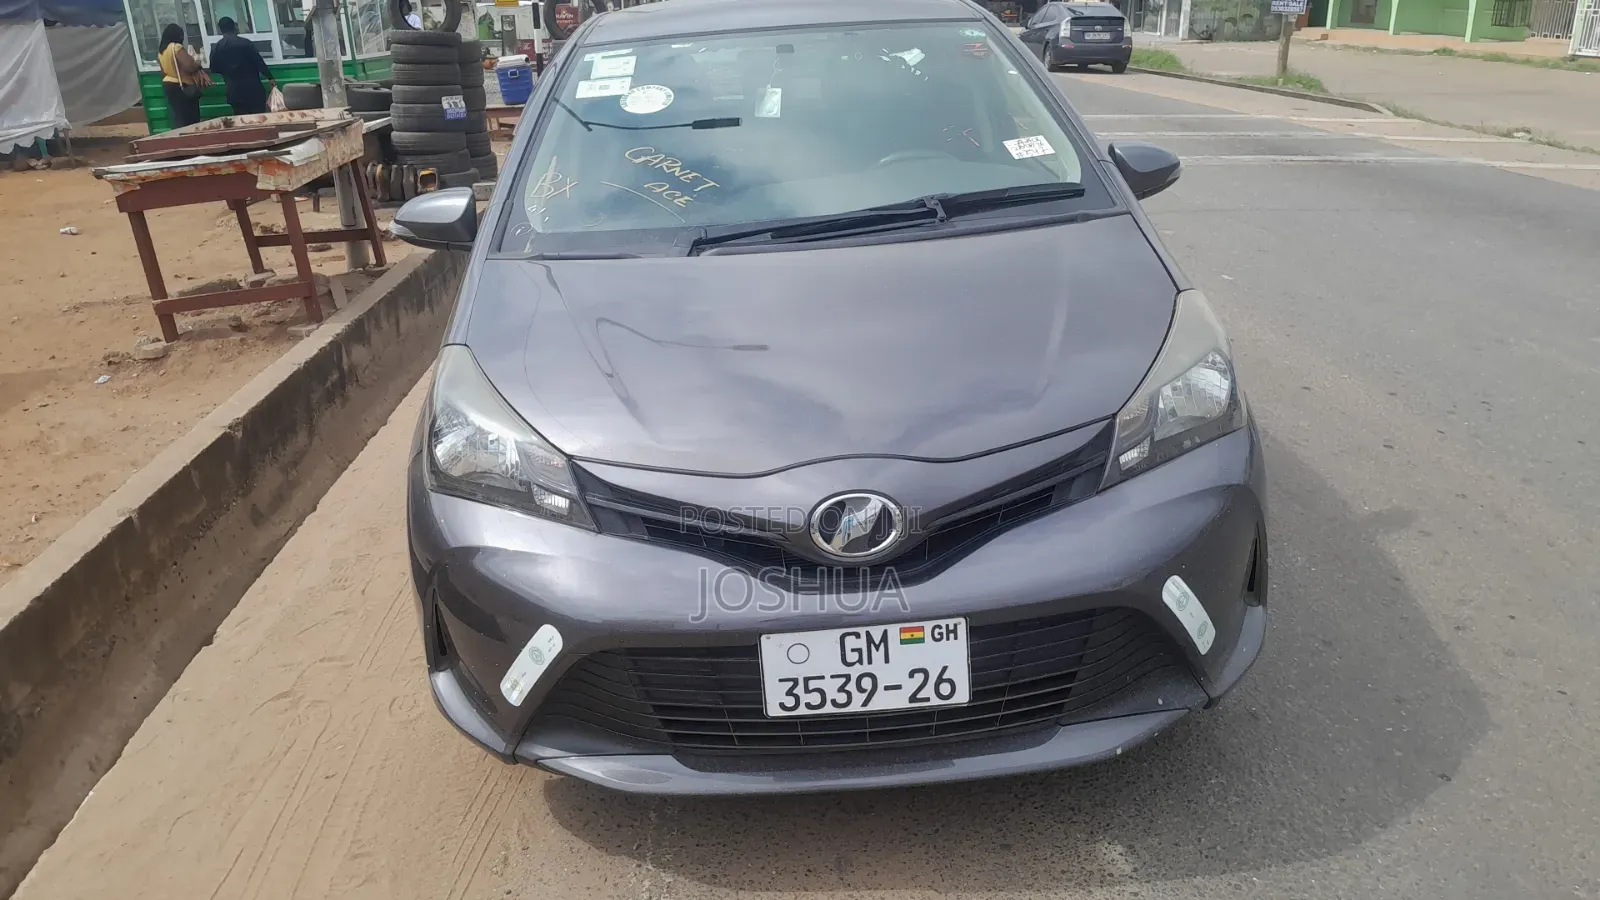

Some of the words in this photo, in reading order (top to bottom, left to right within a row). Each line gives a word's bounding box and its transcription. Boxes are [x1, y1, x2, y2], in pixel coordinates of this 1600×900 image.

[643, 182, 694, 208] ACE
[839, 628, 890, 667] GM
[930, 623, 959, 643] GH
[778, 665, 957, 712] 3539-26
